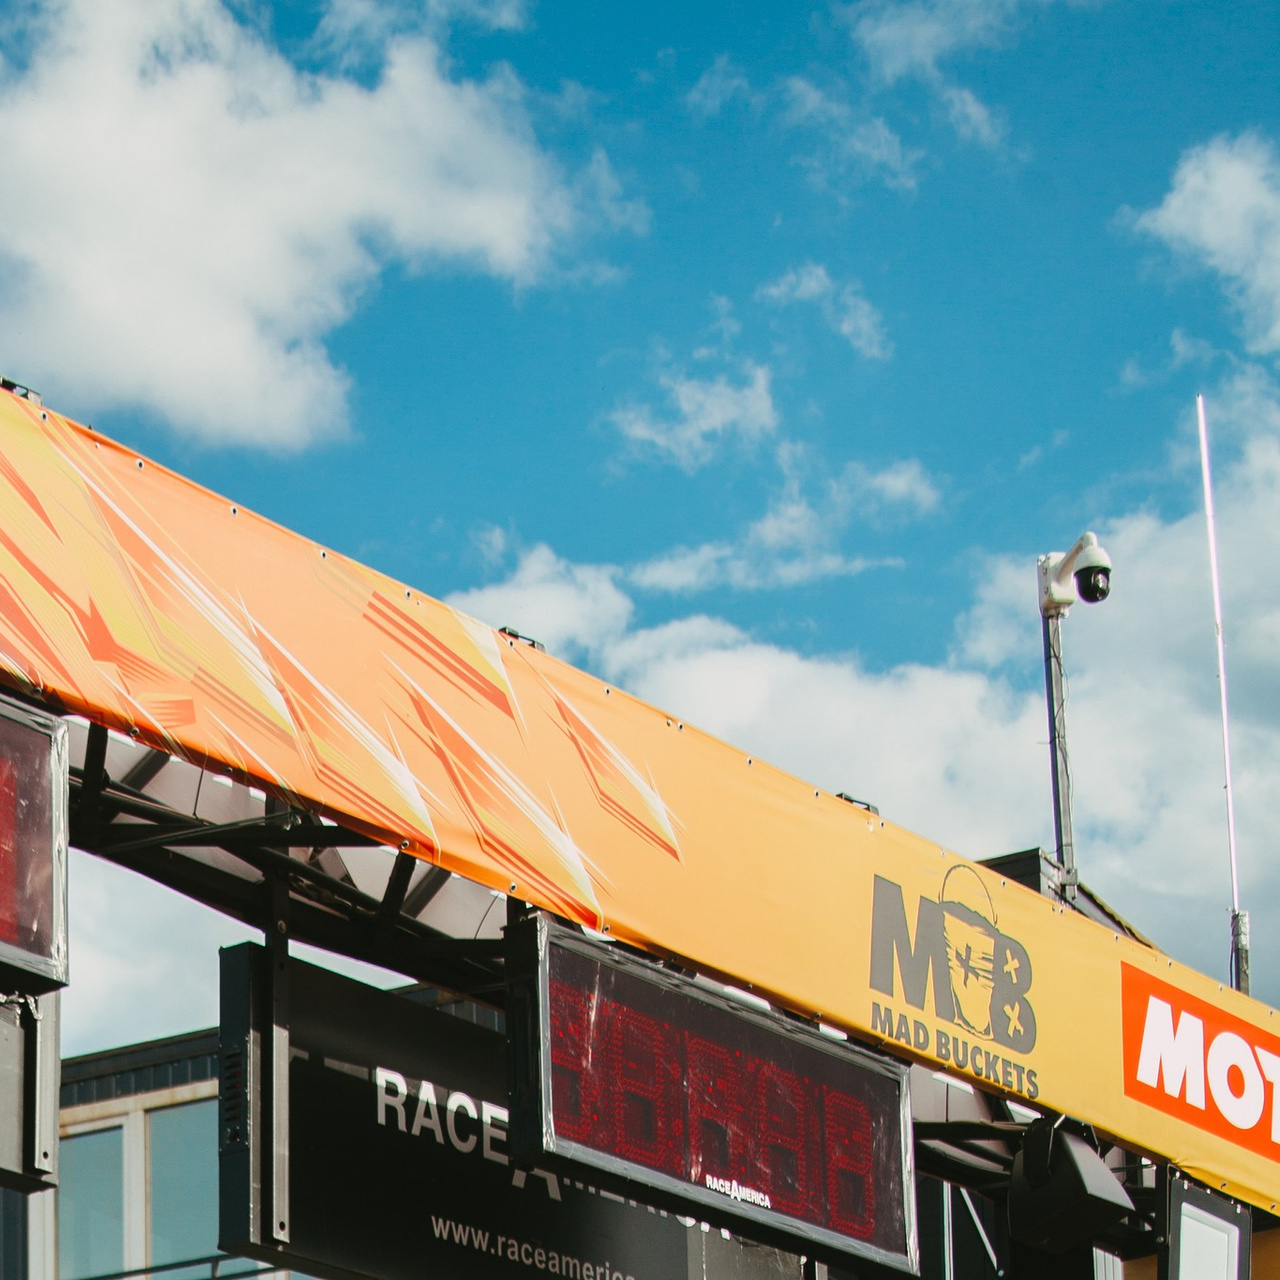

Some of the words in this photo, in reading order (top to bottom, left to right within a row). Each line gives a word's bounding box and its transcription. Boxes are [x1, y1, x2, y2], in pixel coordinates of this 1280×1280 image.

[870, 1002, 930, 1052] MAD
[935, 1030, 1040, 1101] BUCKETS
[705, 1173, 771, 1209] RACEAMERICA
